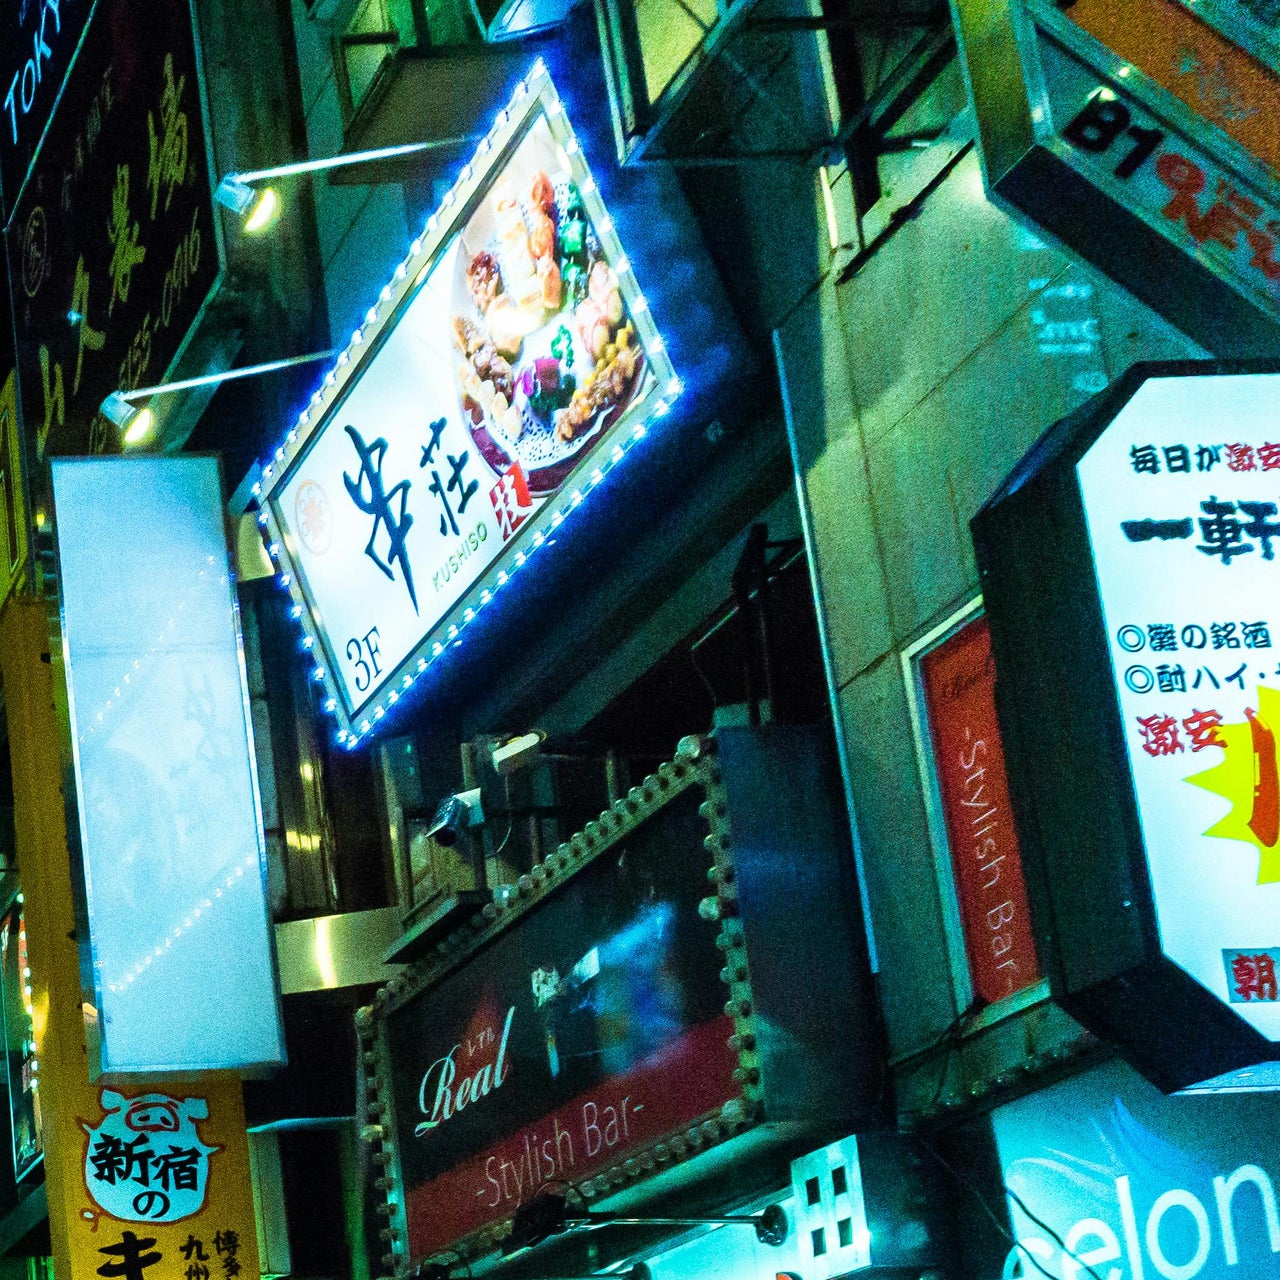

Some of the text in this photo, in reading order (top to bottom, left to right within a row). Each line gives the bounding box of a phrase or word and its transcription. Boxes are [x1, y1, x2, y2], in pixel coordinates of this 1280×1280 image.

[1063, 100, 1164, 178] B1
[431, 521, 489, 593] KUSHISO
[345, 626, 383, 692] 3F
[415, 1006, 516, 1138] Real
[89, 1132, 203, 1191] 新宿
[132, 1193, 170, 1219] の
